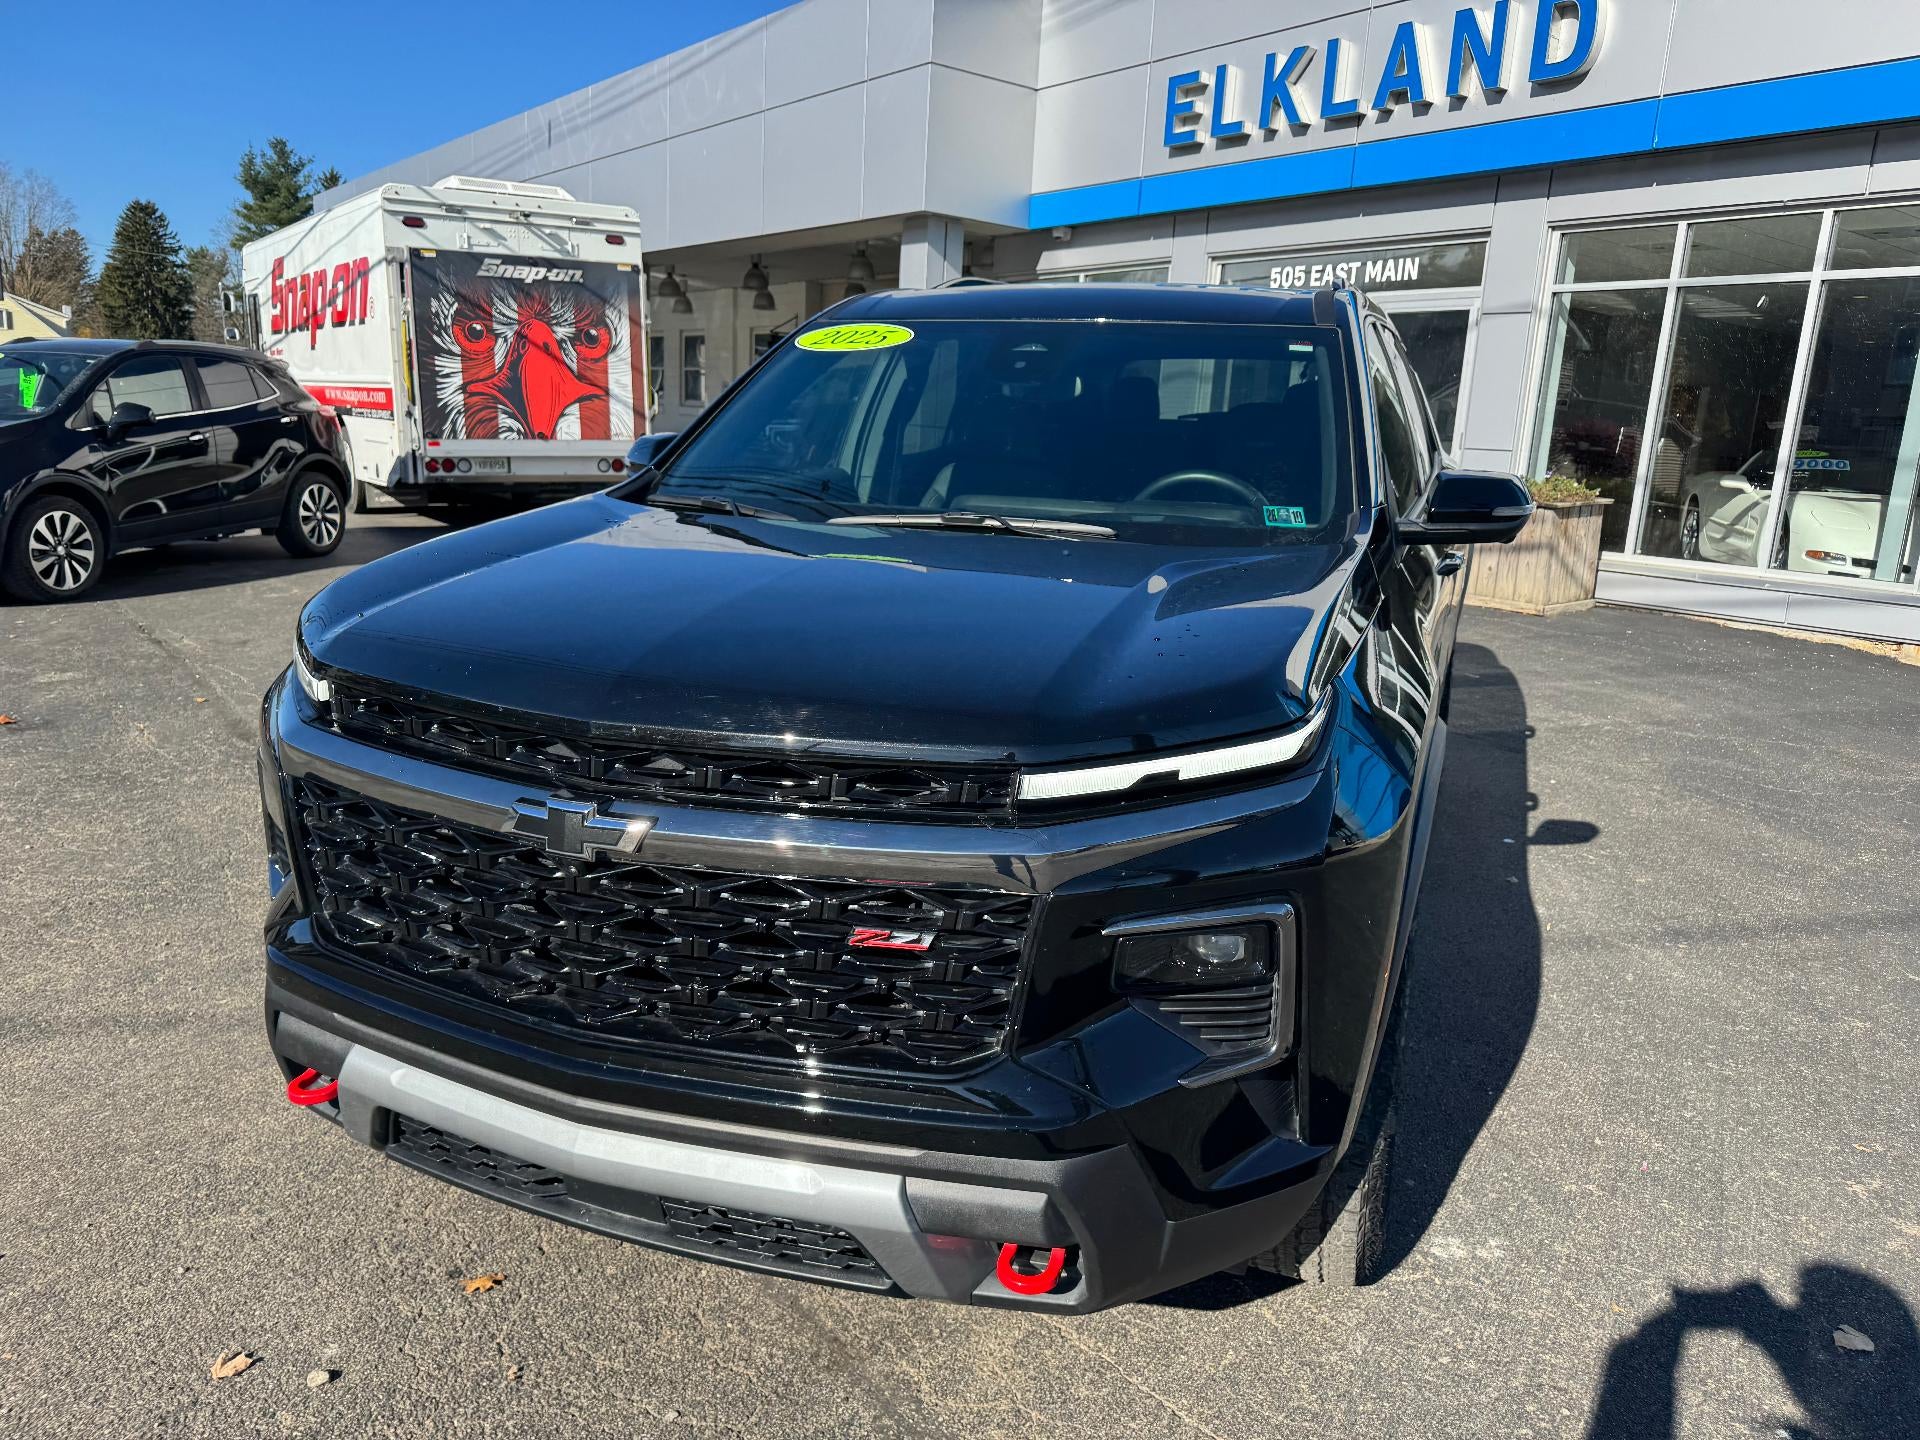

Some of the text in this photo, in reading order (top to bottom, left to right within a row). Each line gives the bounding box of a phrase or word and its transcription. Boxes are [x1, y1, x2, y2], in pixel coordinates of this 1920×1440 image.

[1163, 0, 1603, 150] ELKLAND
[1270, 256, 1420, 288] 505 EAST MAIN
[271, 256, 369, 350] Snap-on
[809, 330, 899, 346] 2025
[324, 387, 387, 405] www.snapon.com
